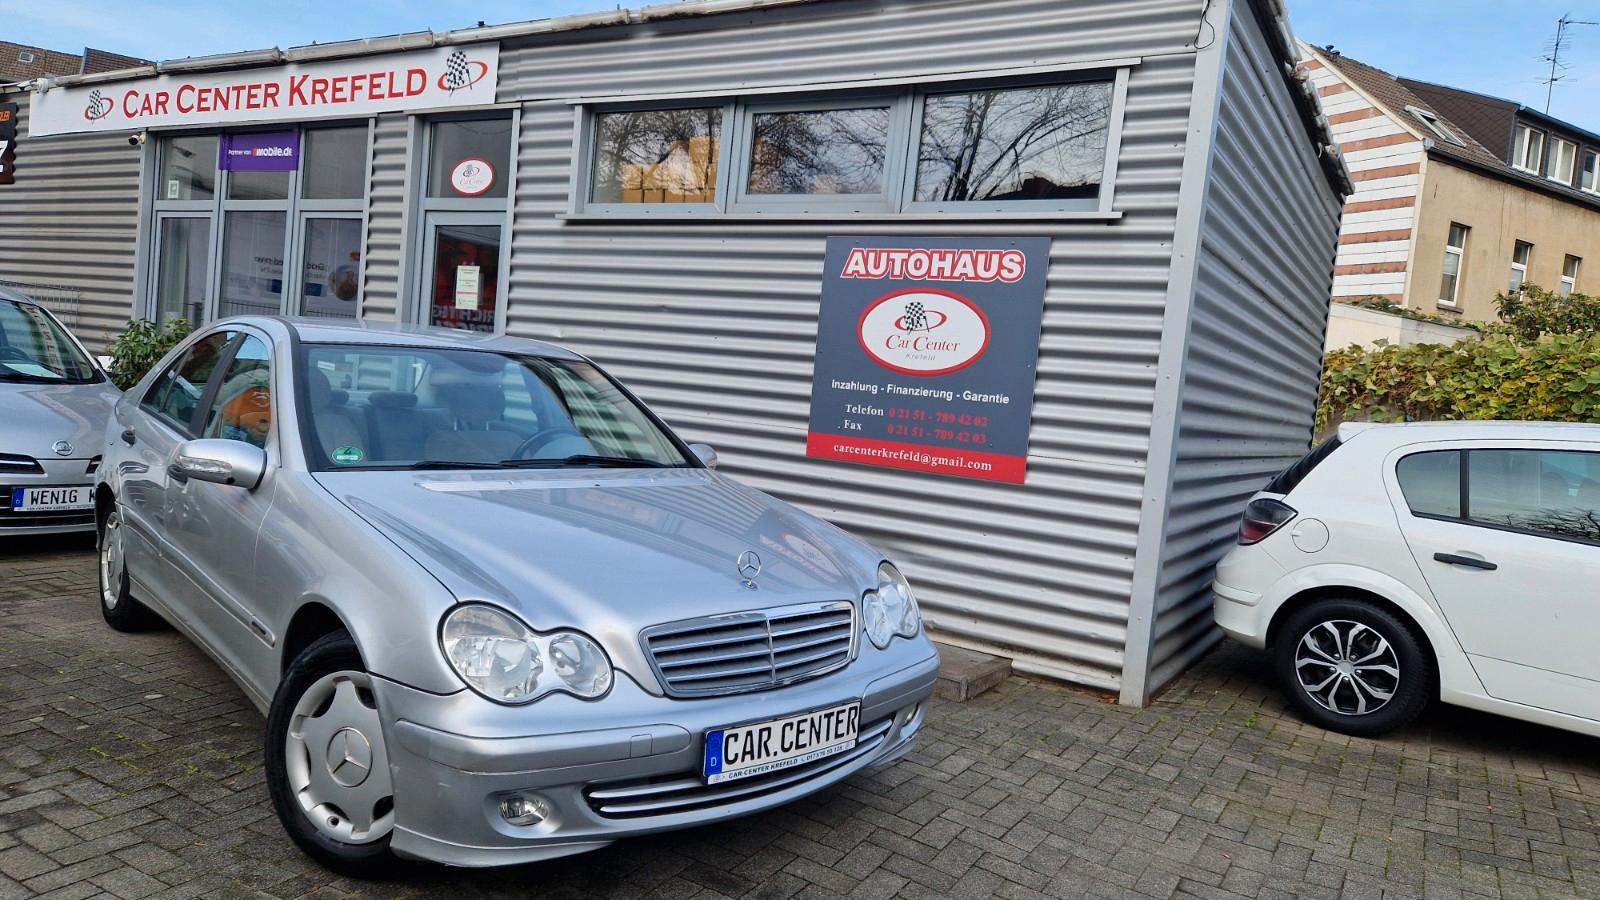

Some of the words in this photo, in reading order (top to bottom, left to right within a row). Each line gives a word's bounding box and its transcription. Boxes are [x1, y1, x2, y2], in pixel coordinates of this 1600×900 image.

[122, 89, 170, 118] CAR
[176, 82, 280, 114] CENTER
[288, 68, 427, 107] KREFELD
[256, 146, 293, 157] mobile.de
[840, 247, 1026, 283] AUTOHAUS
[885, 334, 911, 350] Car
[912, 336, 960, 351] Center
[831, 379, 878, 395] Inzahlung
[886, 383, 953, 401] Finanzierung
[962, 390, 1010, 404] Garantie
[845, 403, 884, 417] Telefon
[843, 419, 862, 431] Fax
[833, 443, 993, 472] carcenterkrefeld@gmail.com
[30, 489, 78, 505] WENIG
[723, 705, 859, 765] CAR.CENTER
